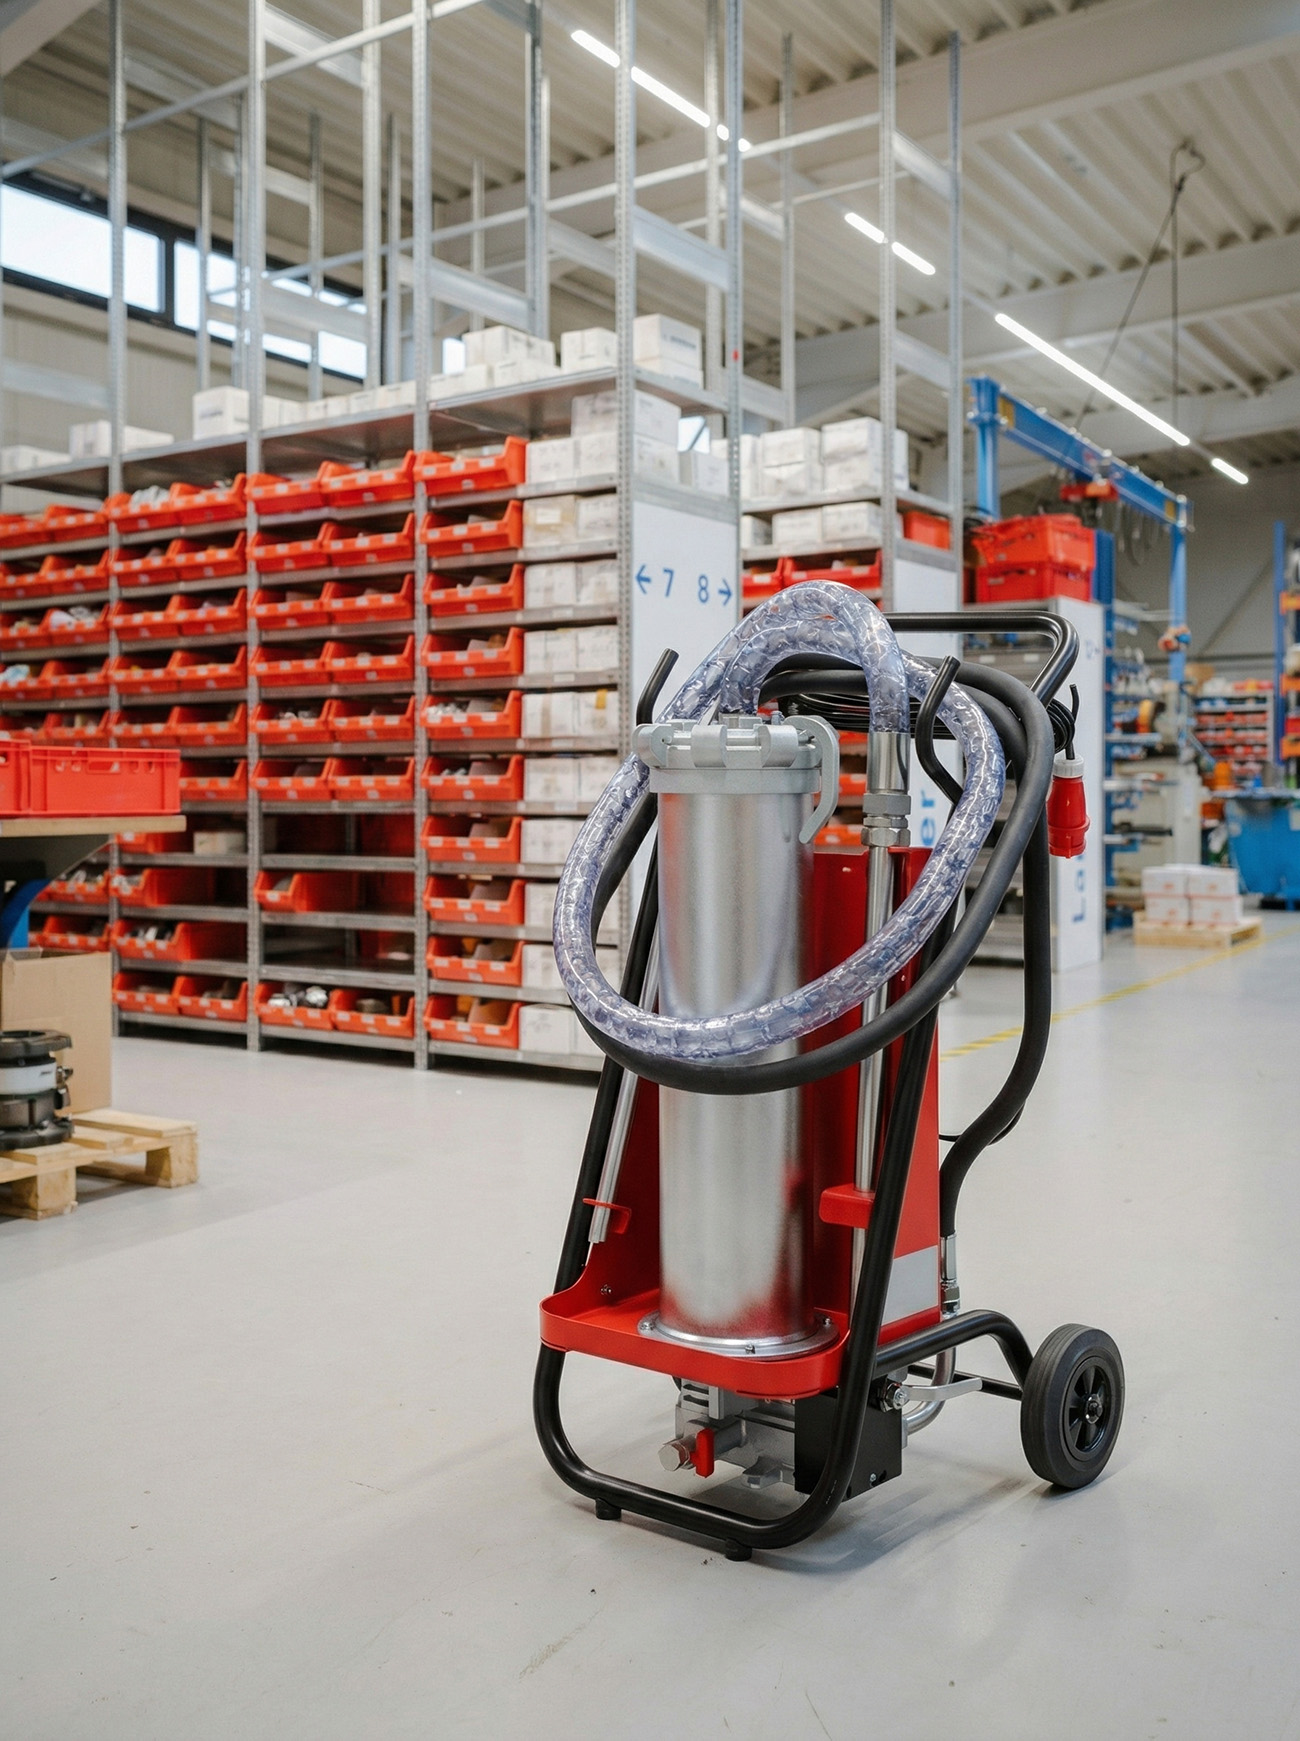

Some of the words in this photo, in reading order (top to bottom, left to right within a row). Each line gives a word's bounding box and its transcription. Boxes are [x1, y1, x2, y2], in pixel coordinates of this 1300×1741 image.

[663, 567, 674, 597] 7
[698, 574, 709, 603] 8
[921, 790, 935, 846] er
[1073, 855, 1085, 922] La
